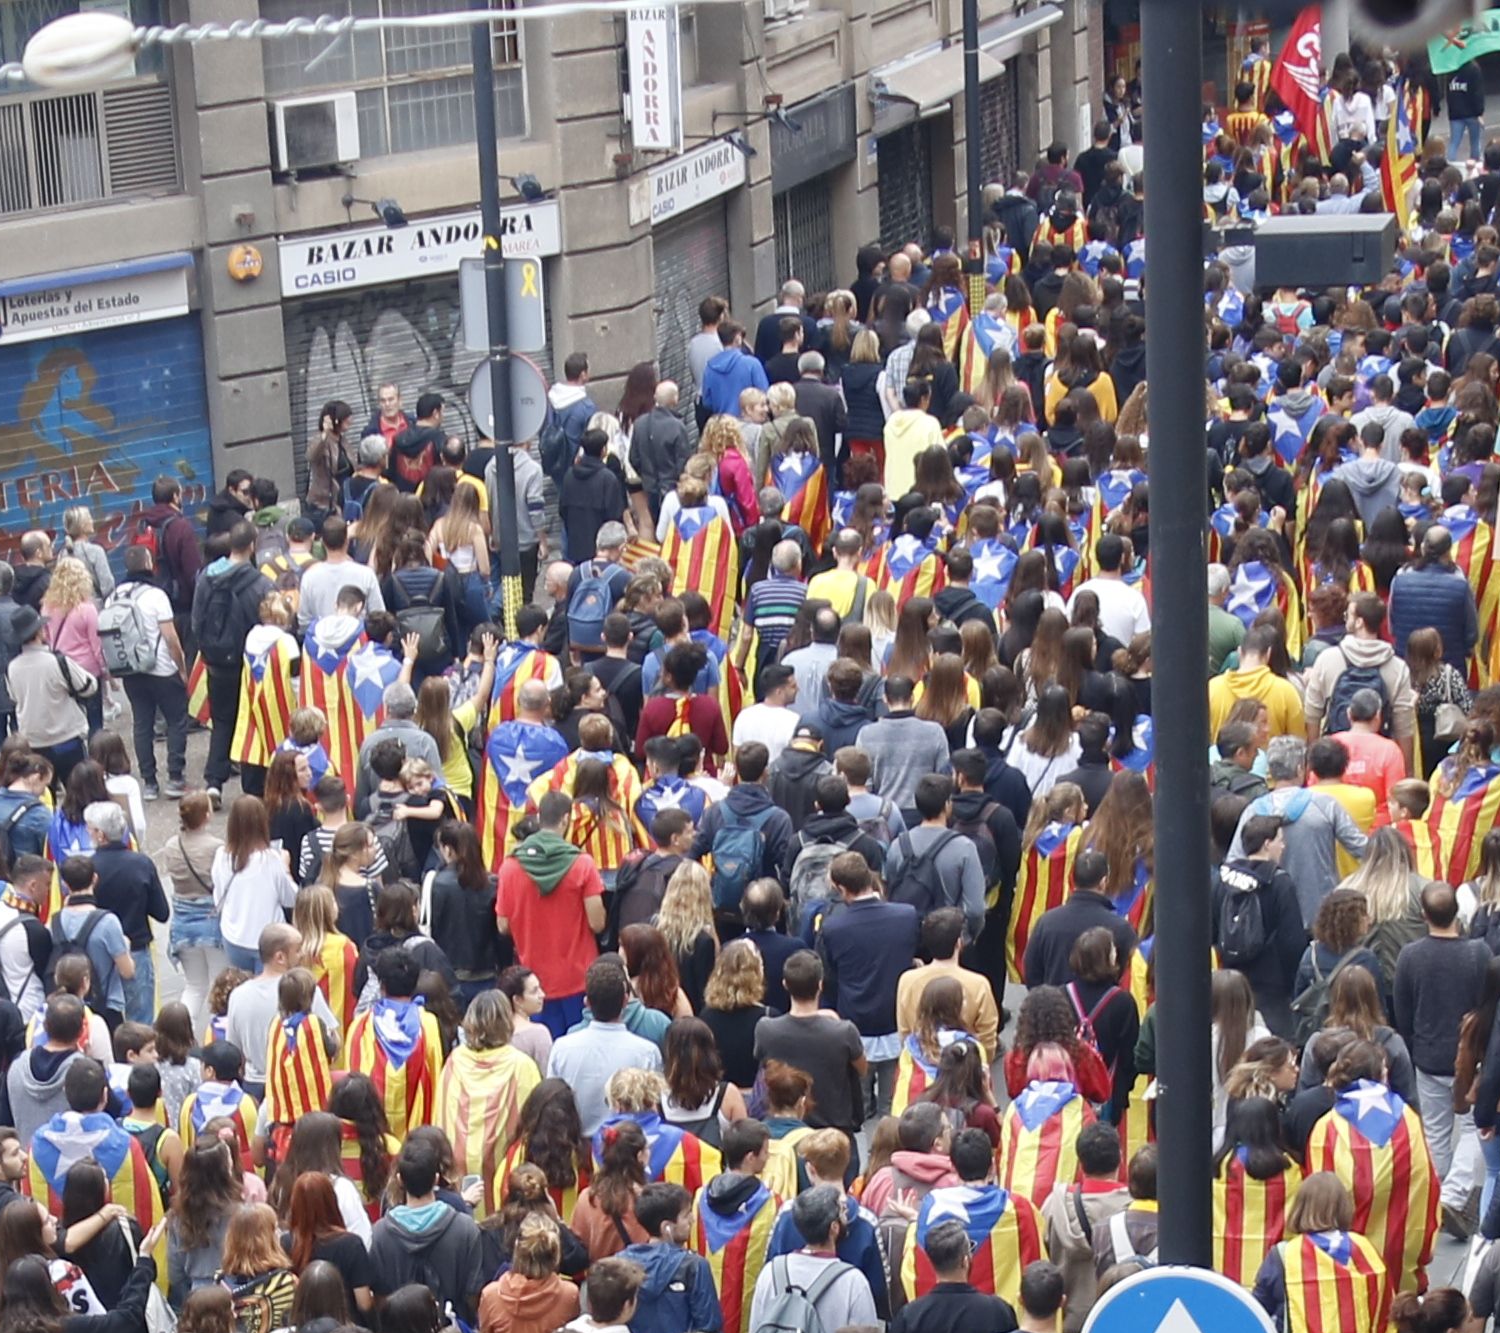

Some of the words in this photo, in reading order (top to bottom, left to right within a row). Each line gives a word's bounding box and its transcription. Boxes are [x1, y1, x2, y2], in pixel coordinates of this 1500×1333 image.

[630, 8, 666, 21] BAZAR
[642, 28, 660, 143] ANDORRA
[657, 165, 688, 197] BAZAR
[651, 197, 676, 218] CASIO
[306, 234, 395, 267] BAZAR
[410, 213, 534, 251] ANDORA
[294, 266, 357, 290] CASIO
[11, 305, 70, 326] Apuestas
[73, 299, 94, 315] del
[96, 292, 141, 310] Estado
[64, 288, 73, 304] y
